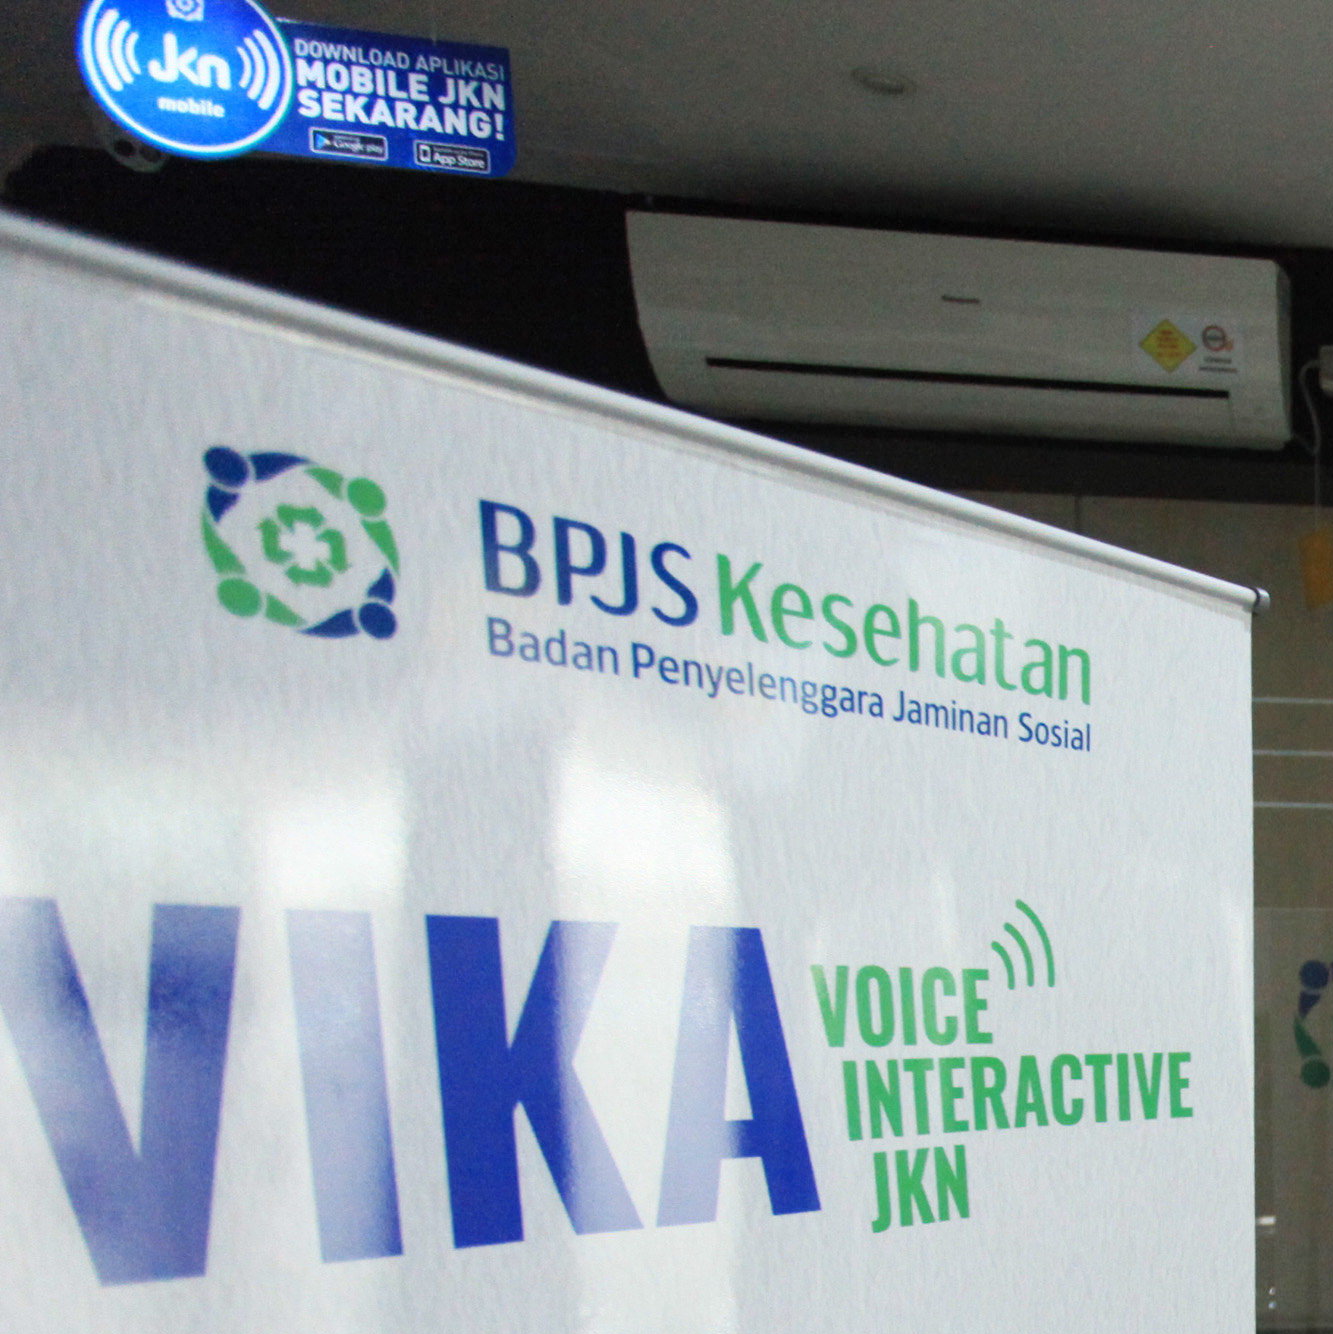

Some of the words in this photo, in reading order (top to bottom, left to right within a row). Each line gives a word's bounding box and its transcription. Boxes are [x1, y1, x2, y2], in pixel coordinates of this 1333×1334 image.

[294, 38, 411, 70] DOWNLOAD
[414, 53, 506, 81] APLIKASI
[297, 58, 430, 94] MOBILE
[438, 75, 506, 111] JKN
[157, 96, 225, 118] mobile
[298, 91, 506, 141] SEKARANG!
[478, 498, 699, 628] BPJS
[716, 553, 1092, 705] Kesehatan
[486, 616, 619, 675] Badan
[631, 642, 883, 718] Penyelenggara
[893, 689, 1009, 739] Jaminan
[1018, 713, 1091, 752] Sosial
[810, 965, 993, 1048] VOICE
[0, 896, 822, 1288] VIKA
[842, 1051, 1194, 1141] INTERACTIVE
[871, 1144, 970, 1233] JKN
